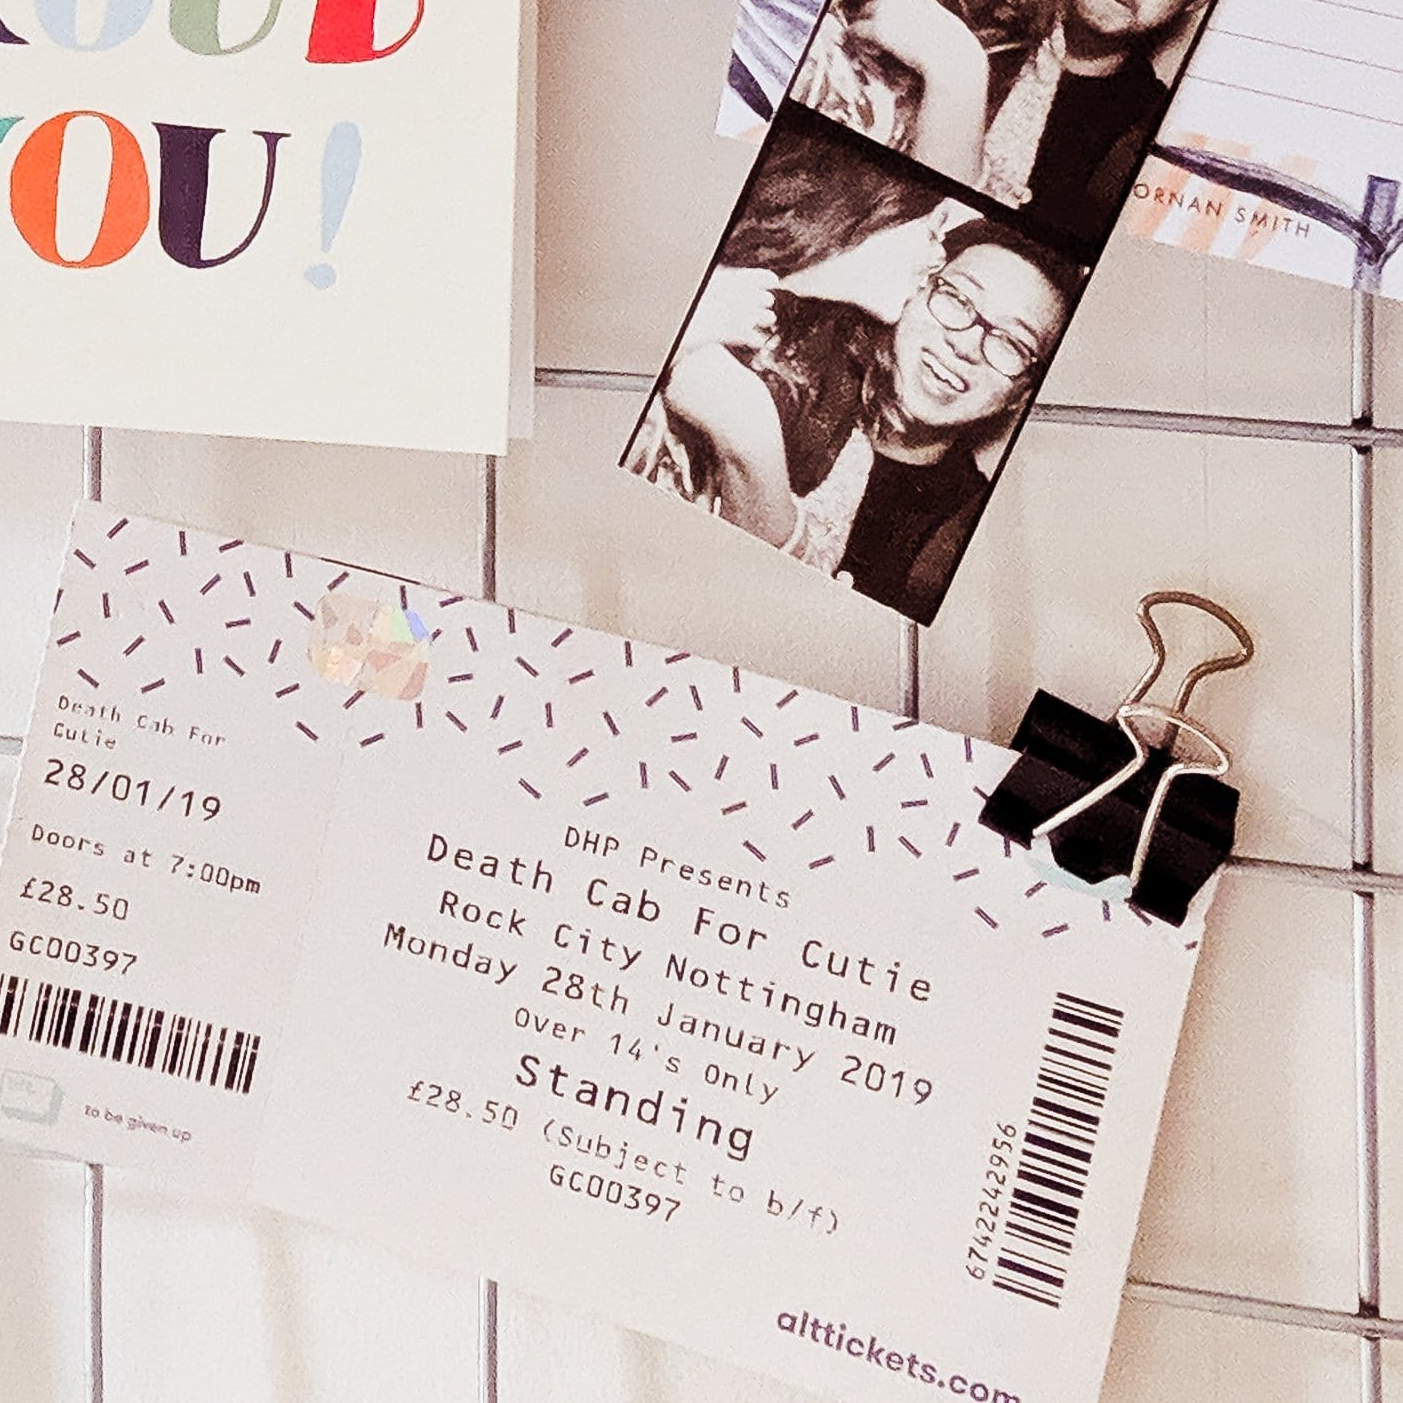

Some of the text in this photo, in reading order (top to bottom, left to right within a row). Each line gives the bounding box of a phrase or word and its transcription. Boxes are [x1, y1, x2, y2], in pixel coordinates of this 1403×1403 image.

[1234, 207, 1310, 237] SMITH
[53, 722, 116, 749] Cutie
[58, 695, 226, 747] Death Cab For
[44, 758, 222, 821] 28/01/19
[31, 823, 262, 895] Doors at 7:00pm
[564, 826, 791, 910] DHP Presents
[19, 877, 129, 921] £28.50
[427, 833, 933, 1002] Death Cab For Cutie
[9, 930, 138, 975] GC00397
[439, 890, 897, 1045] Rock City Nottingham
[383, 923, 934, 1106] Monday 28th January 2019
[514, 1007, 781, 1106] Over 14's Only
[85, 1105, 192, 1143] to be given up
[515, 1054, 755, 1162] Standing
[407, 1080, 838, 1235] £28.50 (Subject to b/f)
[549, 1165, 681, 1222] GC00397
[965, 1123, 1017, 1280] 6742242956
